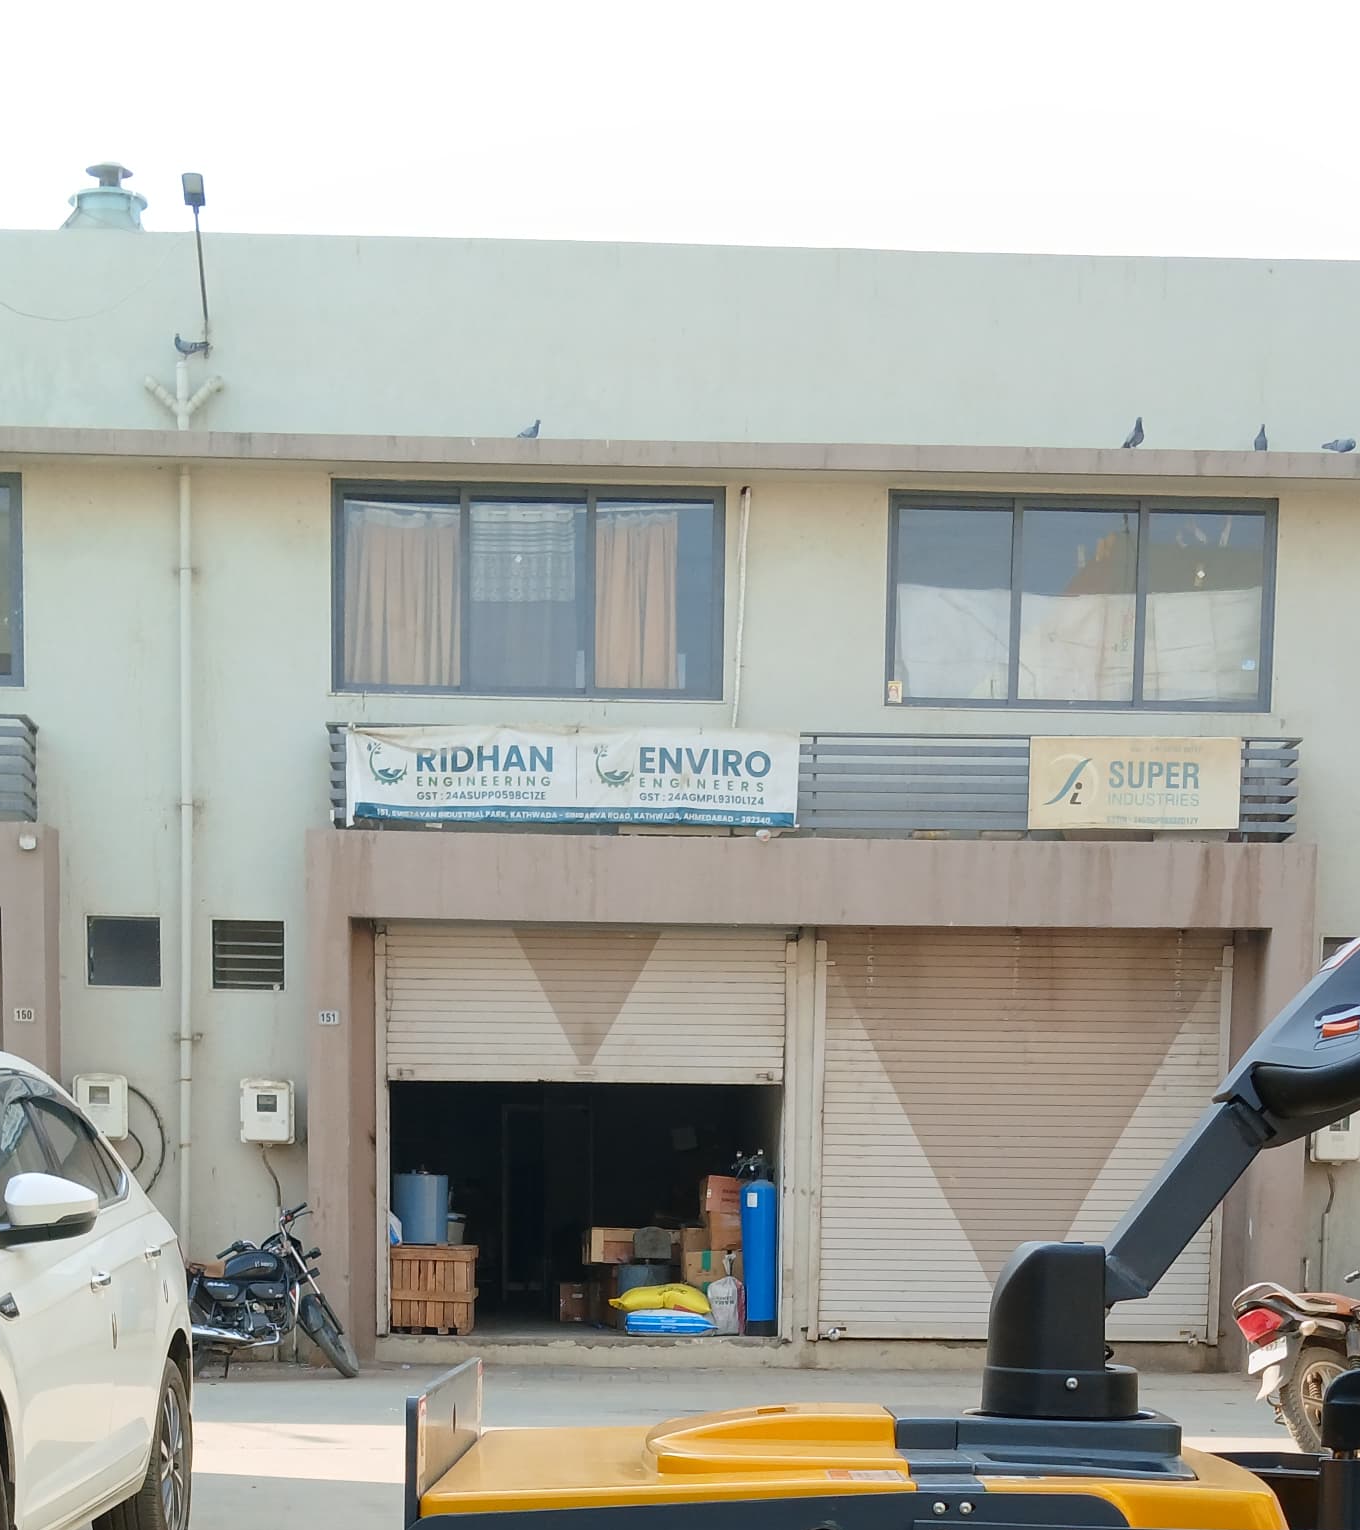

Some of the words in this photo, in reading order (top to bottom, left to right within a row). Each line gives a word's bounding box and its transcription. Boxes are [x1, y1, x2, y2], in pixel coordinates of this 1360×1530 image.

[416, 744, 553, 773] RIDHAN
[639, 746, 772, 778] ENVIRO
[416, 775, 551, 787] ENGINEERING
[1109, 760, 1200, 790] SUPER
[639, 777, 765, 793] ENGINEERS
[1107, 791, 1200, 807] INDUSTRIES
[510, 811, 558, 819] KATHWADA
[683, 813, 734, 823] AHMEDABAD
[320, 1012, 336, 1023] 151
